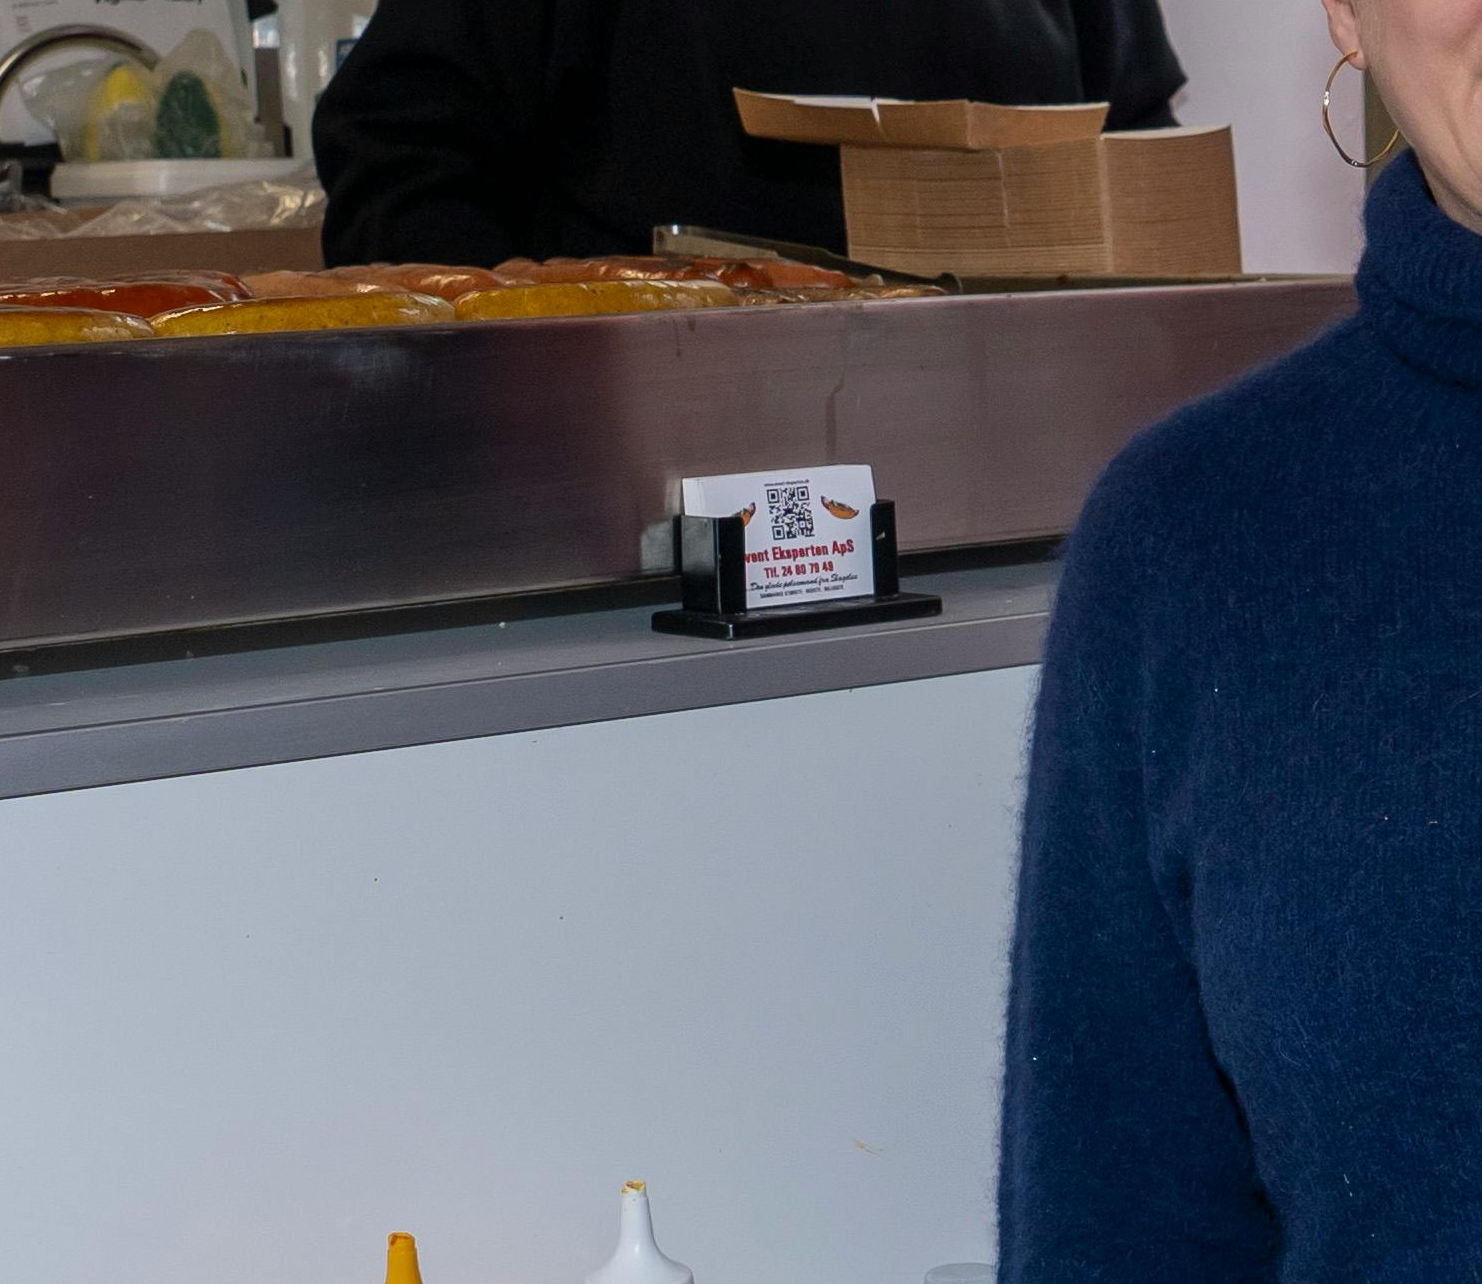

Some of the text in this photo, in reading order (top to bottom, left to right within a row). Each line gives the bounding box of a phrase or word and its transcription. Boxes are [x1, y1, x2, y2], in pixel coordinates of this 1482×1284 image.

[744, 538, 855, 564] vent Eksperten ApS
[781, 564, 793, 578] 24
[822, 560, 834, 573] 49
